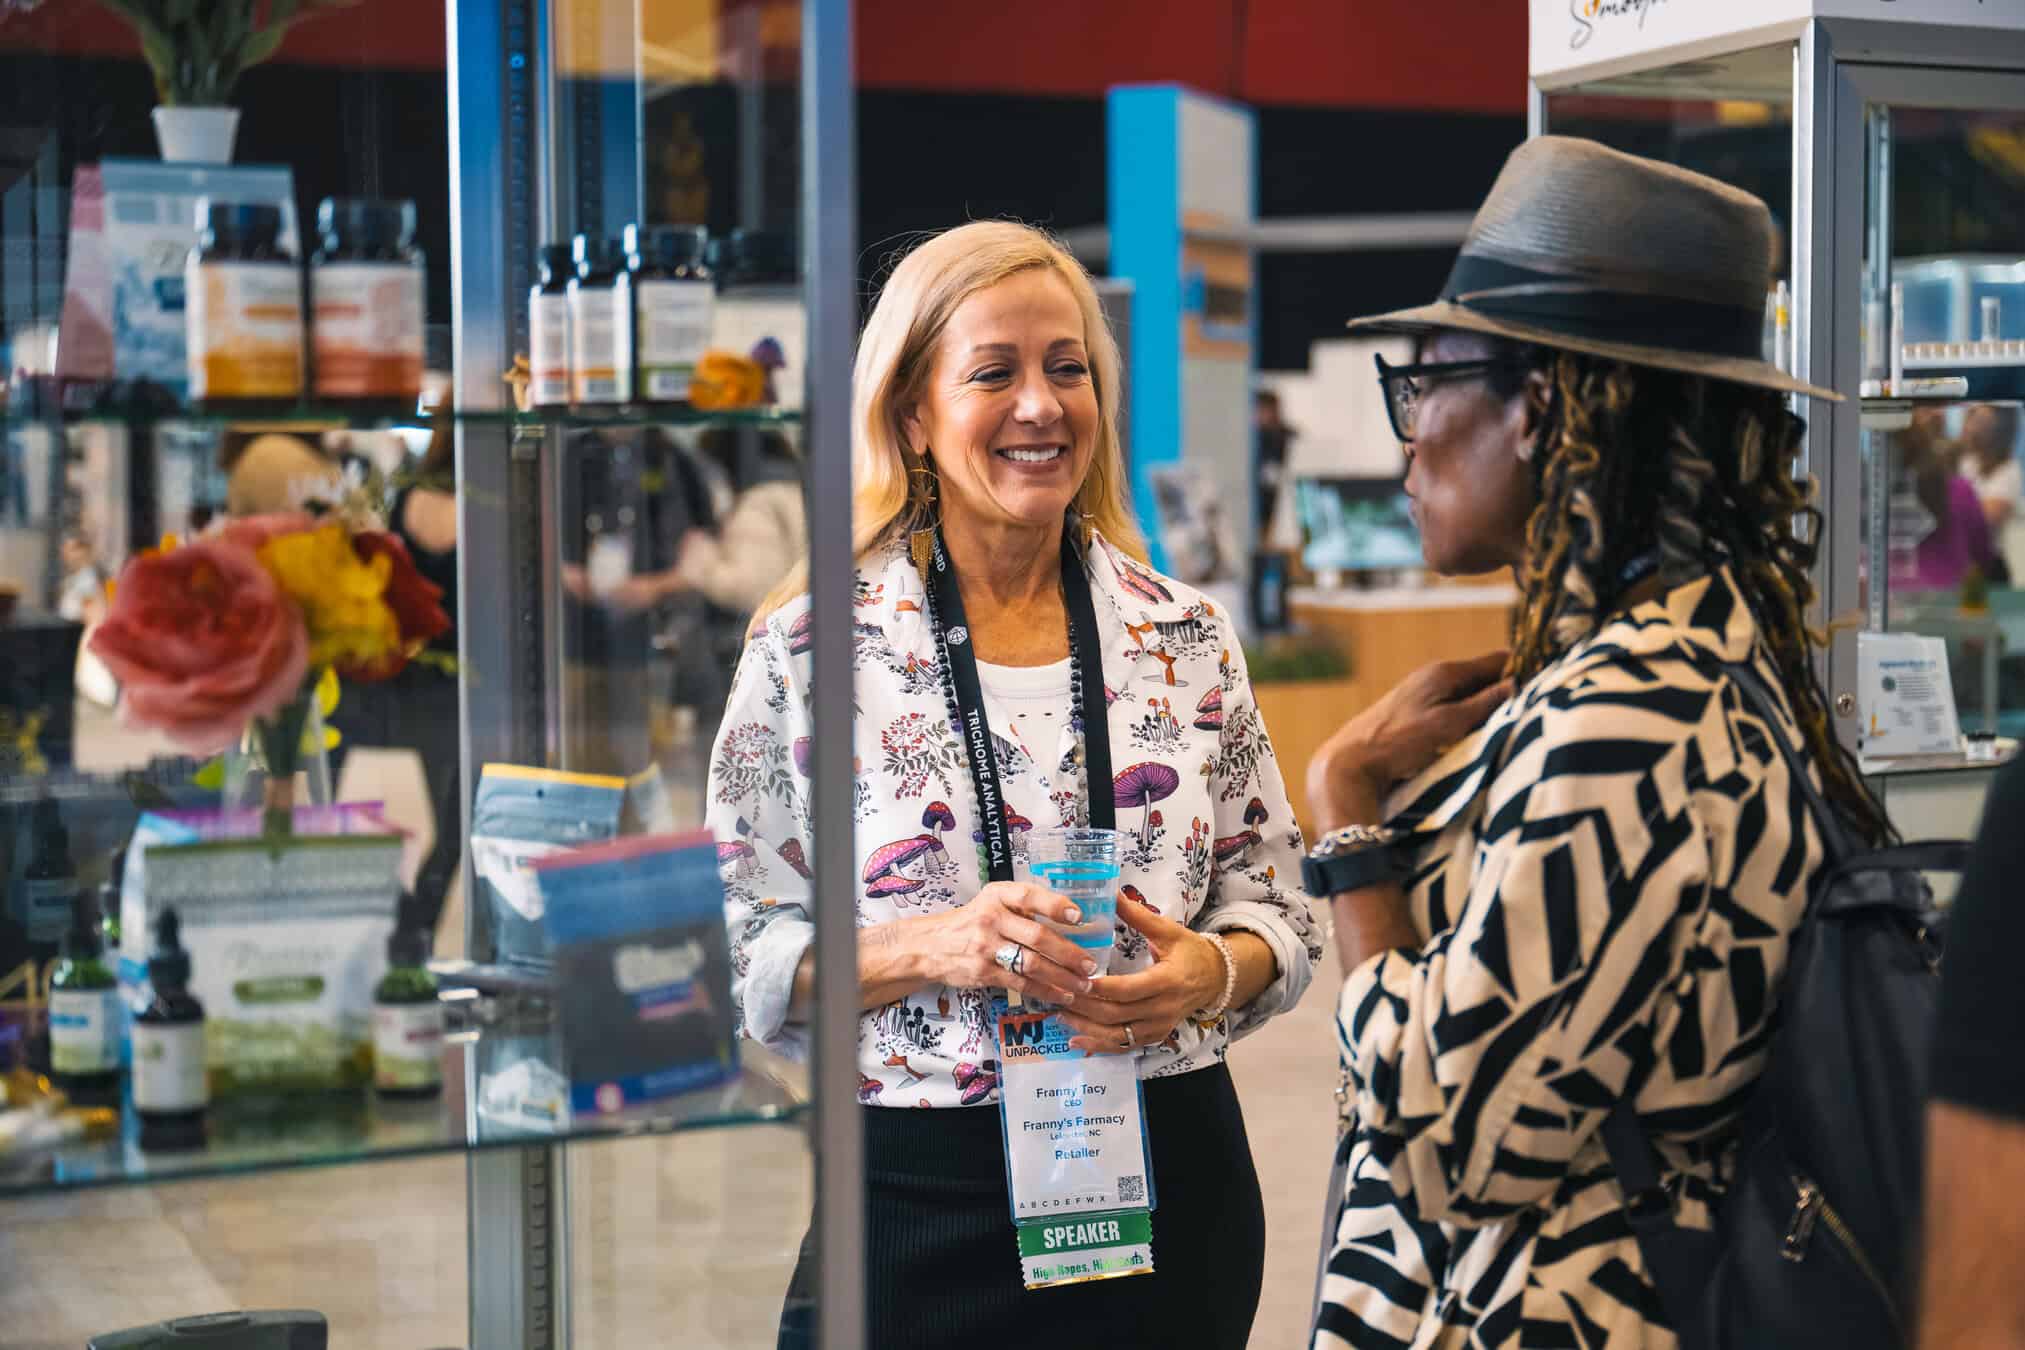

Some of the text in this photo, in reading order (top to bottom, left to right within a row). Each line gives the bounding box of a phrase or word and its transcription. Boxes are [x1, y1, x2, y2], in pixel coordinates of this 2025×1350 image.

[967, 708, 1005, 868] TRICHOME ANALYTICAL
[1003, 1020, 1044, 1046] MJ
[1005, 1042, 1070, 1058] UNPACKED
[1036, 1083, 1107, 1099] Franny Tacy
[1064, 1099, 1082, 1107] CEO
[1023, 1114, 1126, 1131] Franny's Farmacy
[1088, 1129, 1102, 1137] NC
[1055, 1147, 1101, 1160] Retailer
[1043, 1220, 1121, 1249] SPEAKER
